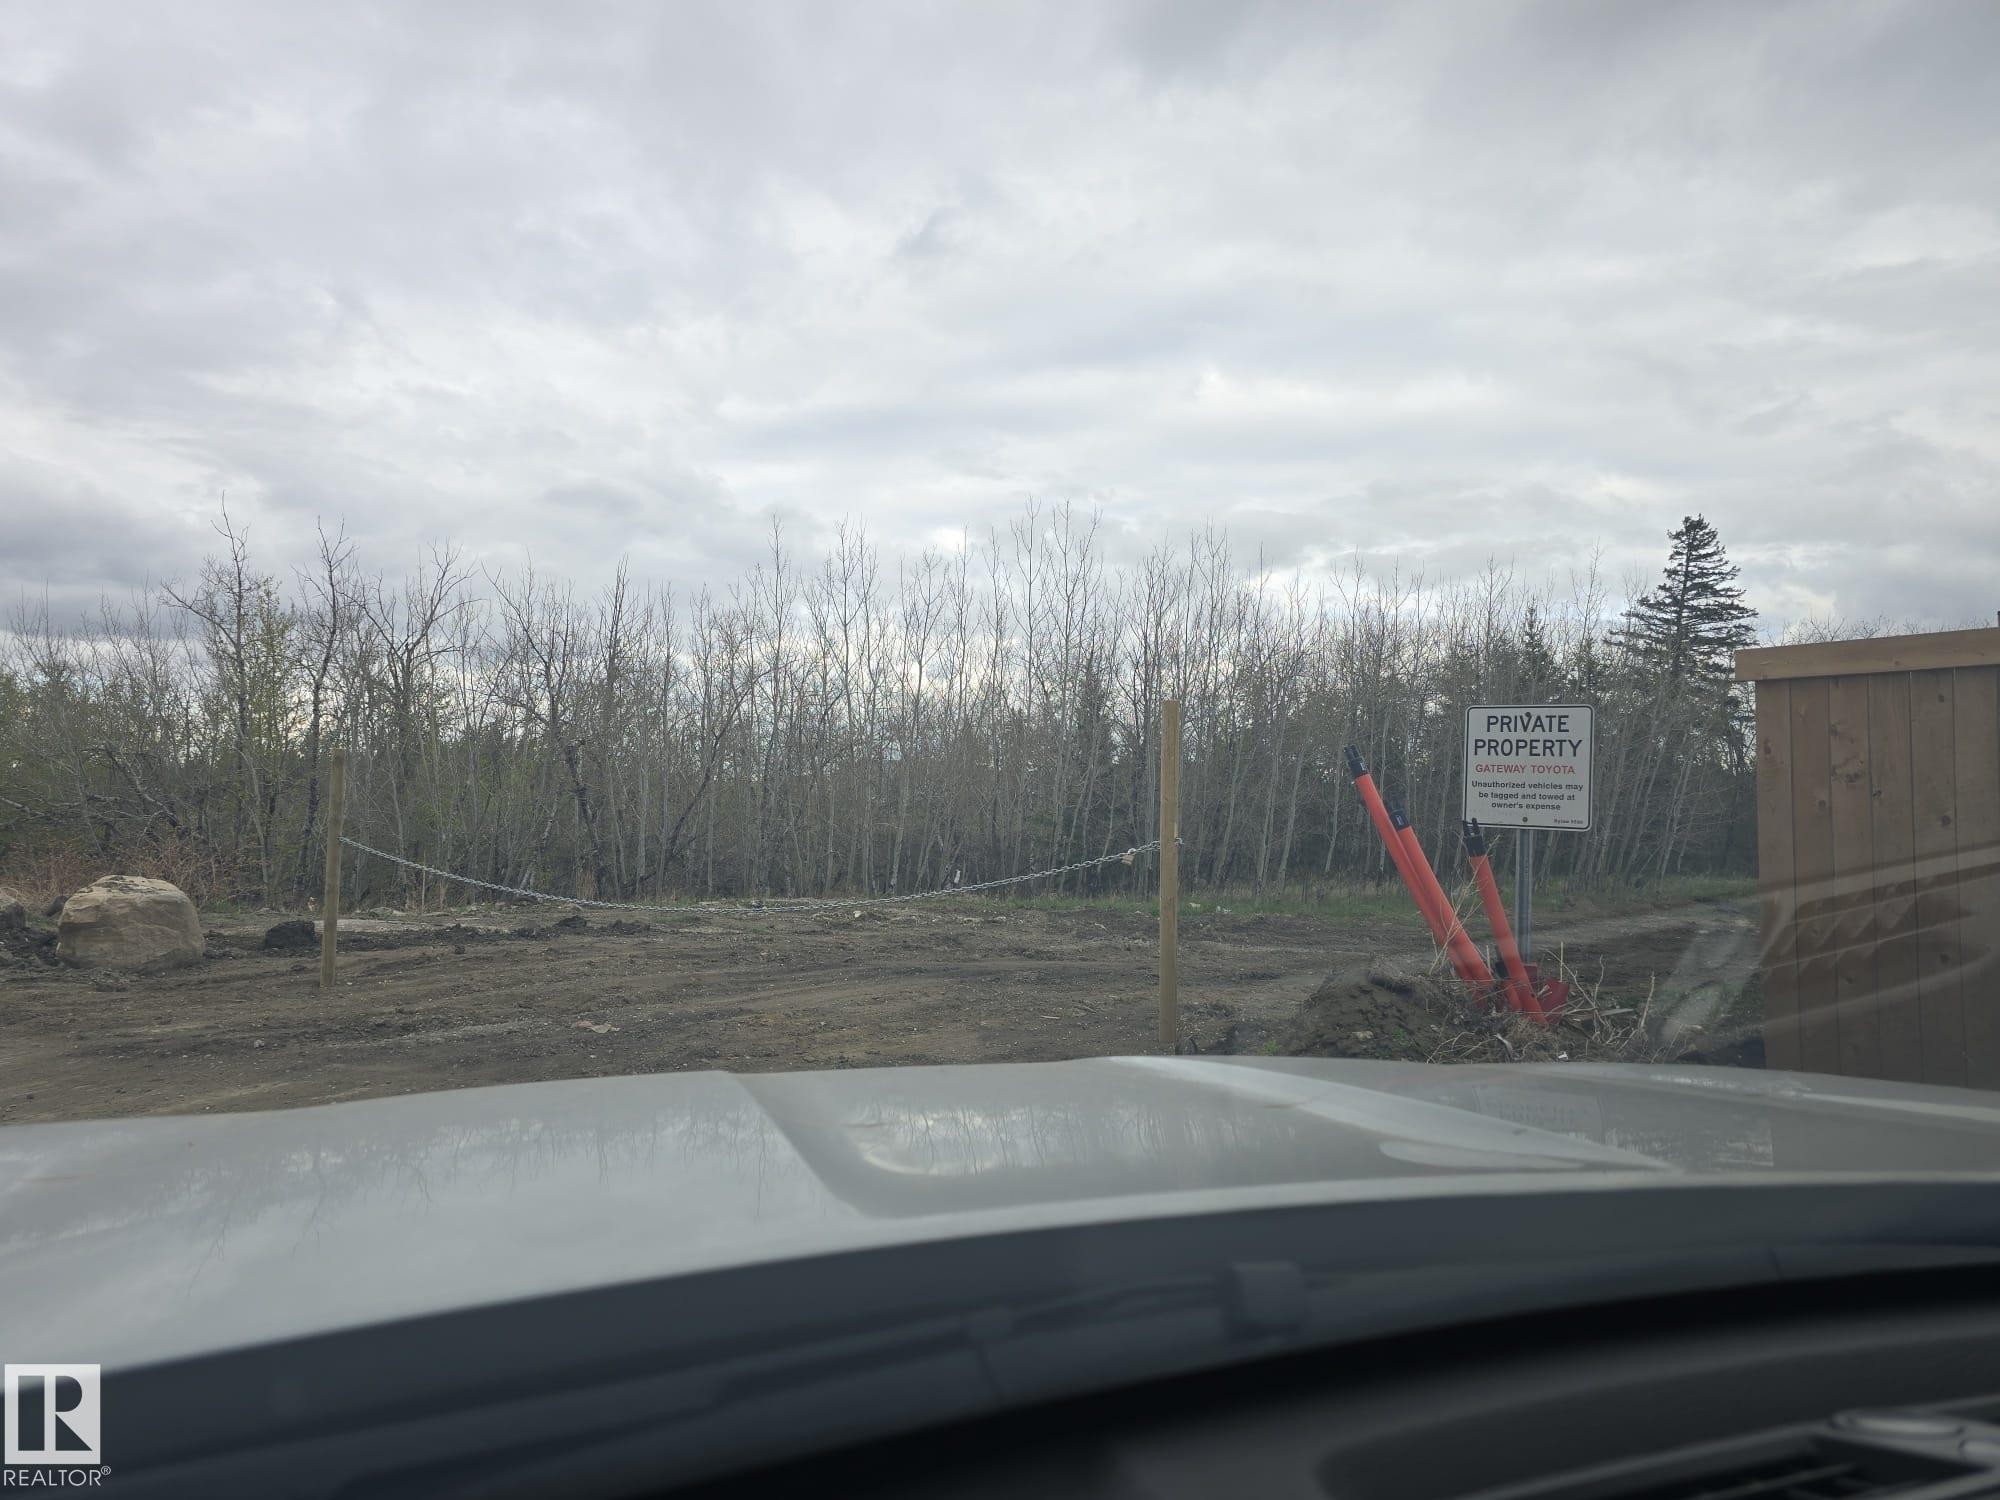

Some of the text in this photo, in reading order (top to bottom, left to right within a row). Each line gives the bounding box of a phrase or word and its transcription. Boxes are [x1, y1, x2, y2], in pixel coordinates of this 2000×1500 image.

[1486, 715, 1569, 732] PRIVATE
[1474, 738, 1582, 757] PROPERTY
[1475, 764, 1576, 775] GATEWAY TOYOTA
[1471, 780, 1584, 792] Unauthorized vehicles may
[1478, 791, 1489, 799] be
[1490, 792, 1519, 801] tagged
[1521, 792, 1537, 800] and
[1538, 793, 1564, 801] towed
[1491, 801, 1561, 811] owner's expense
